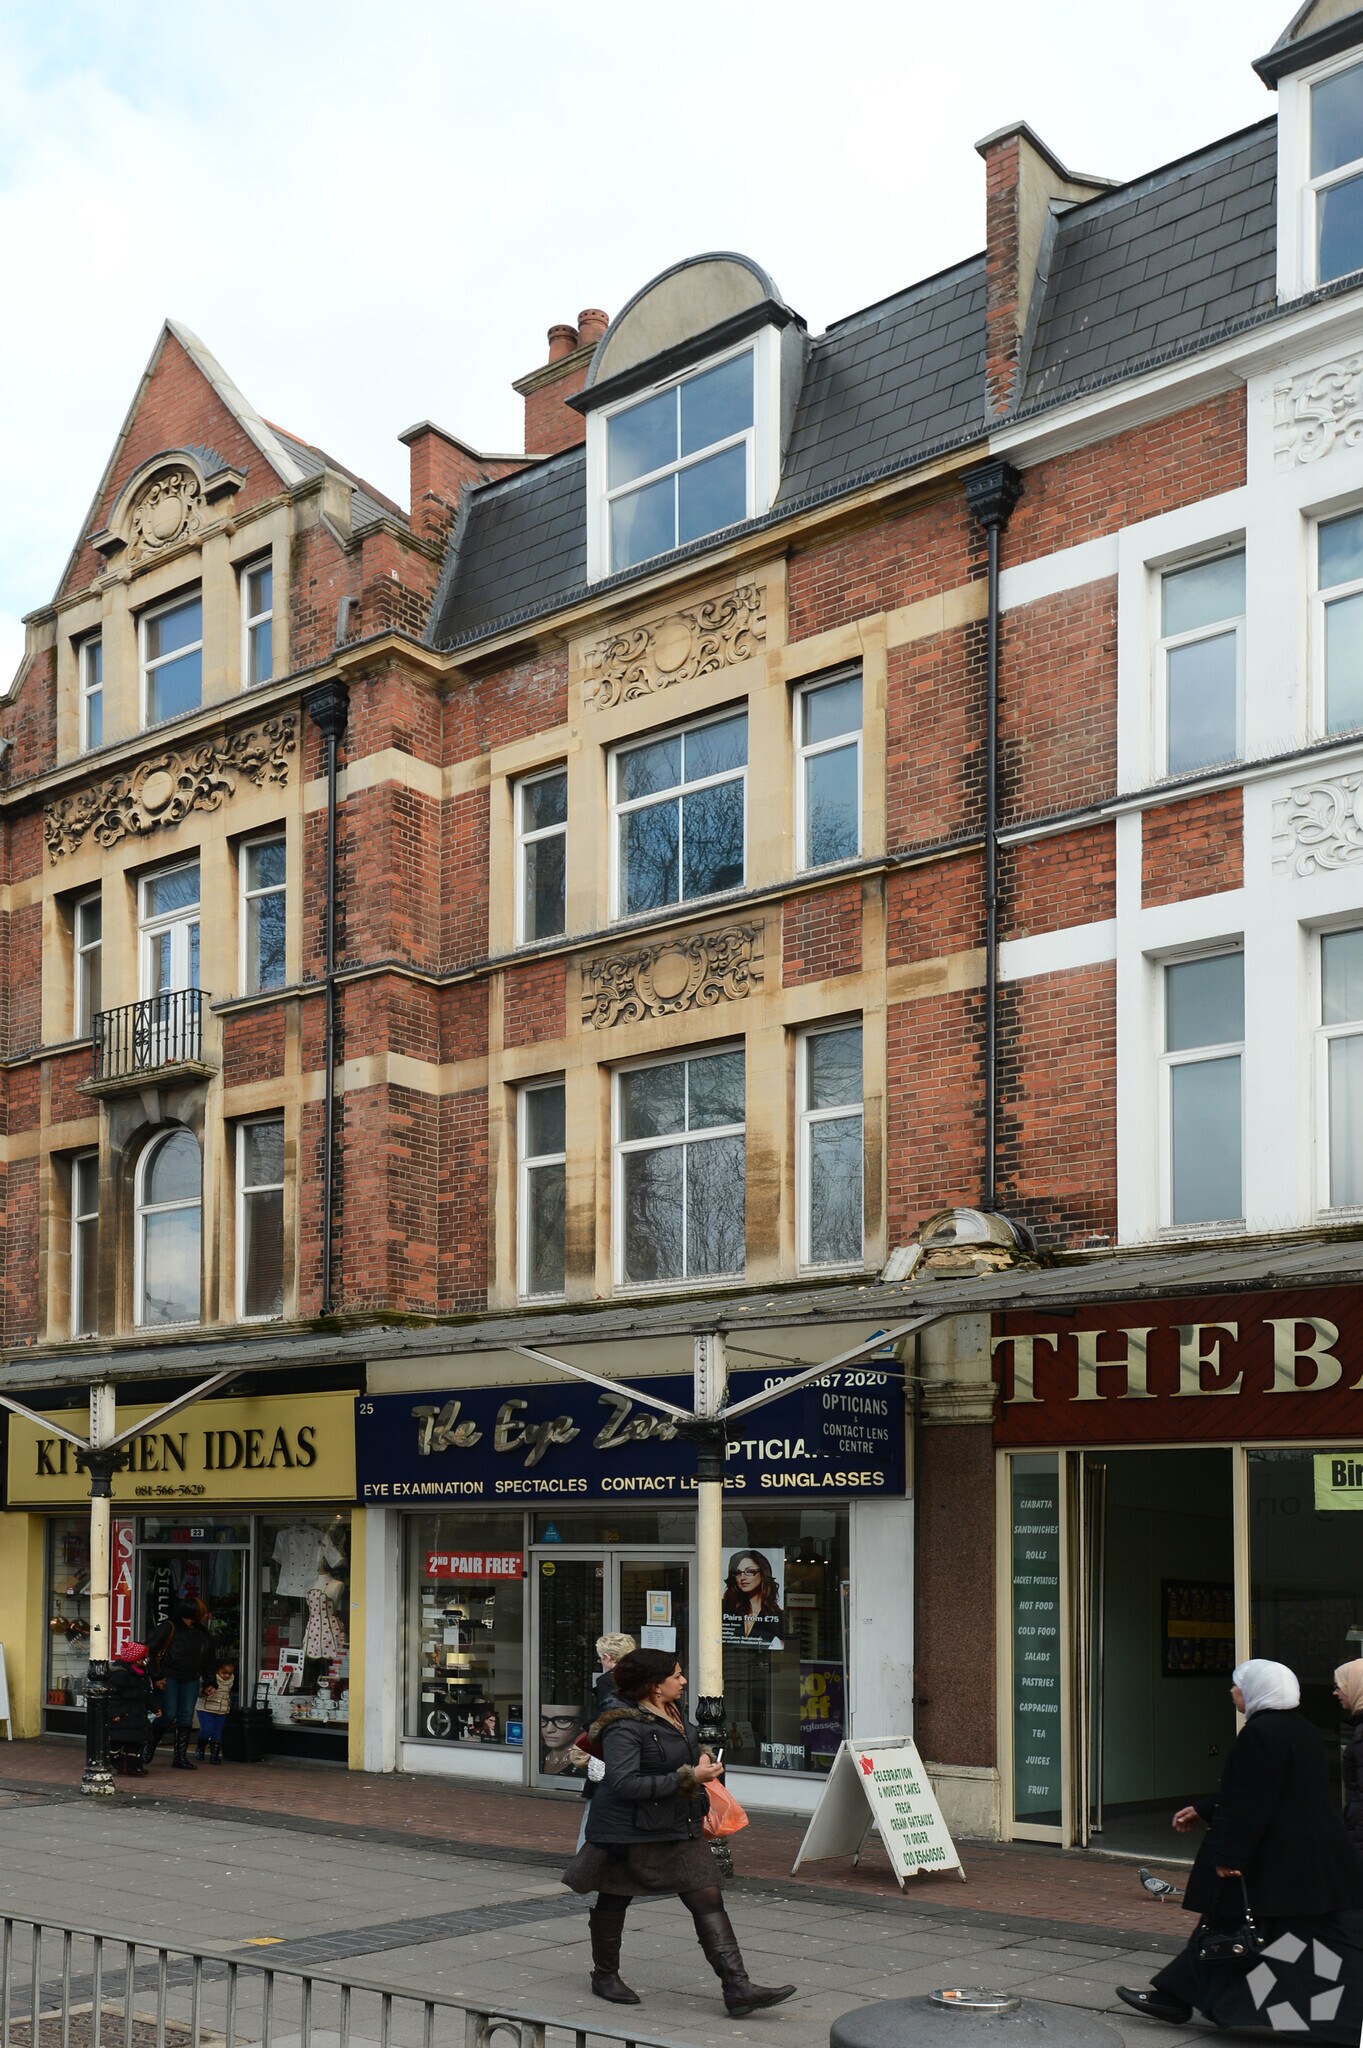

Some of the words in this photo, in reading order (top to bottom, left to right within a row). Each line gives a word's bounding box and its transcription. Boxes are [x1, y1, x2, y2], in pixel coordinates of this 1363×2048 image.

[991, 1321, 1244, 1403] THE
[1262, 1316, 1363, 1394] B
[844, 1371, 888, 1387] 2020
[359, 1403, 374, 1415] 25
[822, 1392, 889, 1417] OPTICIANS
[411, 1400, 483, 1456] The
[493, 1399, 581, 1467] Eye
[823, 1422, 864, 1439] CONTACT
[866, 1426, 889, 1441] LENS
[202, 1426, 317, 1470] IDEAS
[725, 1438, 828, 1461] PTICIA
[838, 1439, 875, 1454] CENTRE
[363, 1483, 389, 1496] EYE
[393, 1481, 484, 1495] EXAMINATION
[495, 1478, 588, 1493] SPECTACLES
[600, 1476, 676, 1491] CONTACT
[680, 1474, 747, 1490] LEES
[760, 1471, 885, 1489] SUNGLASSES
[1020, 1500, 1053, 1509] CIABATTA
[192, 1529, 202, 1537] 23
[1013, 1525, 1060, 1535] SANDWICHES
[1025, 1550, 1047, 1560] ROLLS
[450, 1556, 482, 1574] PAIR
[1013, 1576, 1033, 1585] JACKET
[1033, 1576, 1058, 1585] POTATOES
[1019, 1601, 1034, 1610] HOT
[1035, 1601, 1055, 1610] FOOD
[723, 1613, 743, 1622] Pairs
[743, 1614, 763, 1622] from
[764, 1615, 780, 1623] £75
[1017, 1626, 1037, 1636] COLD
[1037, 1626, 1057, 1636] FOOD
[1024, 1652, 1051, 1662] SALADS
[800, 1670, 841, 1697] 0%
[1021, 1677, 1055, 1688] PASTRIES
[1019, 1702, 1059, 1714] CAPPACINO
[800, 1721, 840, 1732] nglasses
[1032, 1729, 1047, 1739] TEA
[761, 1743, 786, 1754] NEVER
[786, 1745, 804, 1755] HIDE
[1025, 1755, 1051, 1766] JUICES
[873, 1767, 914, 1783] CELEBRATION
[882, 1784, 905, 1799] NOVELTY
[904, 1782, 922, 1797] CAKES
[1027, 1785, 1050, 1796] FRUIT
[895, 1801, 913, 1815] FRESH
[890, 1817, 909, 1831] CREAM
[903, 1833, 912, 1846] TO
[910, 1831, 930, 1845] ORDER
[903, 1850, 916, 1867] 020
